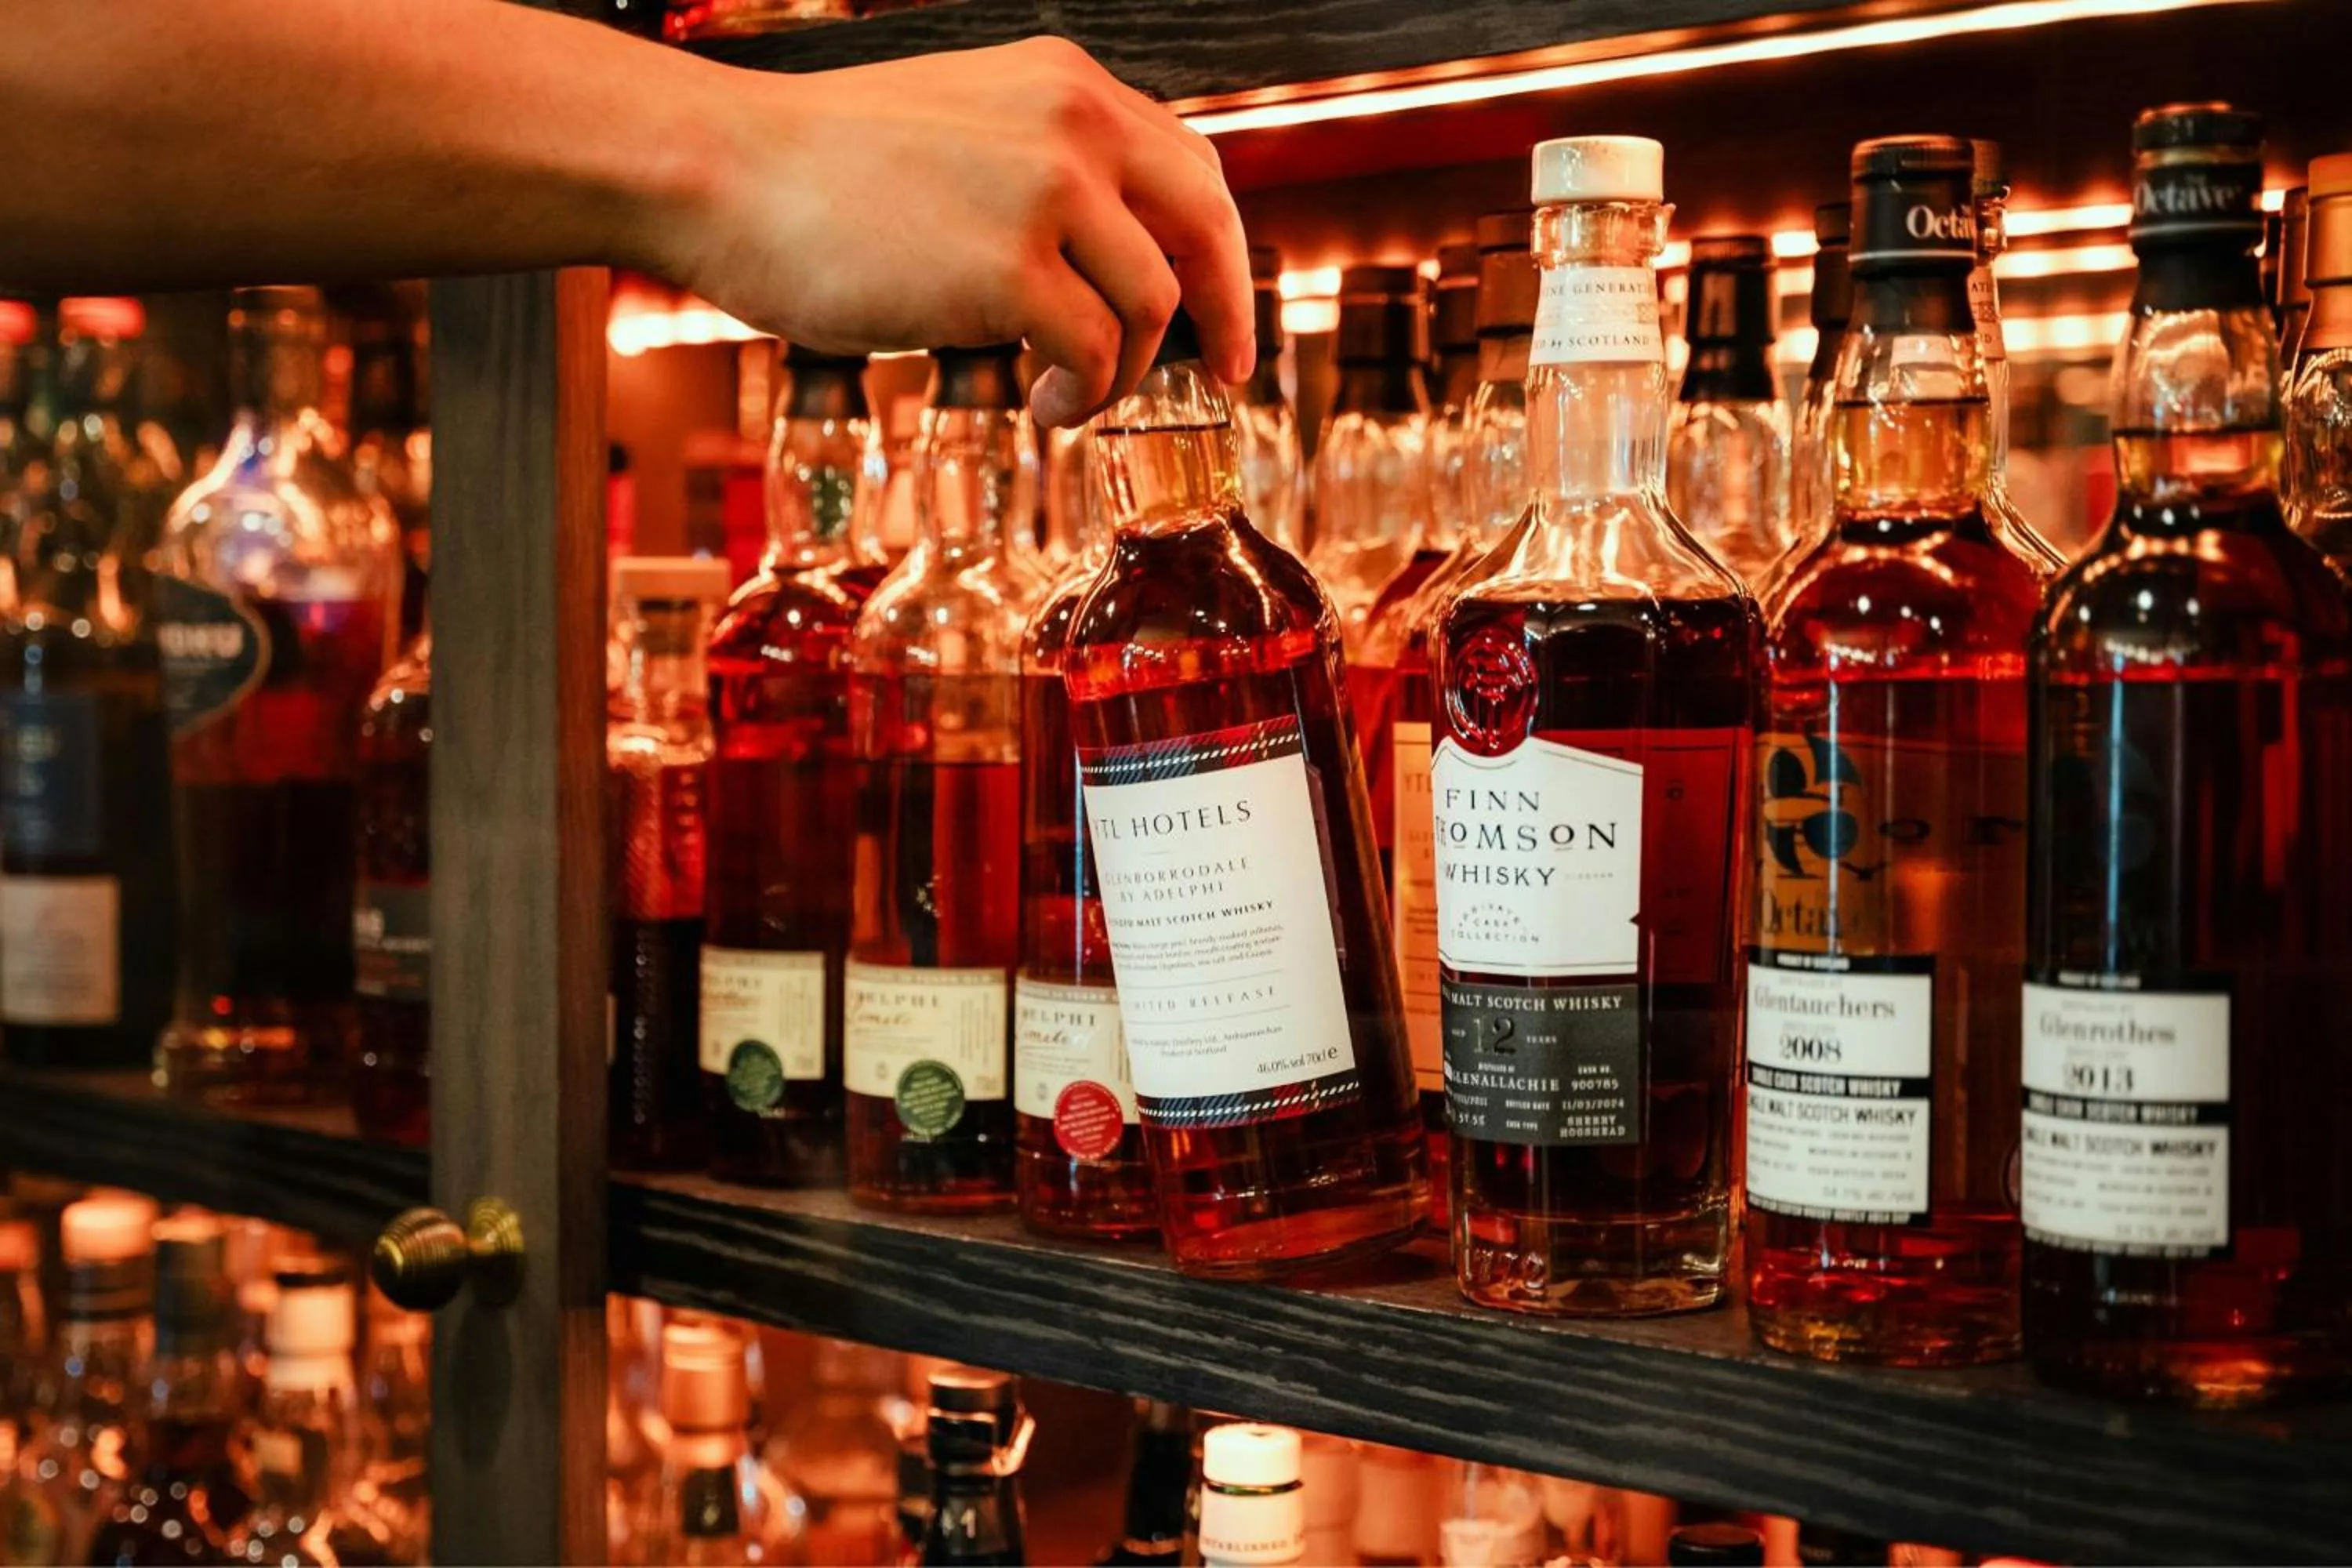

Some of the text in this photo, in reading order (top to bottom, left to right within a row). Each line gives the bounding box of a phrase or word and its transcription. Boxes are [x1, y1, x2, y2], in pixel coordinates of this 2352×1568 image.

[1569, 333, 1650, 347] SCOTLAND
[1446, 789, 1540, 811] FINN
[1131, 800, 1252, 838] HOTELS
[1142, 882, 1225, 903] ADELPHI
[1167, 911, 1216, 926] SCOTCH
[1221, 899, 1273, 918] WHISKY
[1451, 993, 1482, 1008] MALT
[1487, 995, 1545, 1012] SCOTCH
[1553, 996, 1623, 1011] WHISKY
[1473, 1017, 1517, 1055] 12
[1779, 1033, 1842, 1062] 2008
